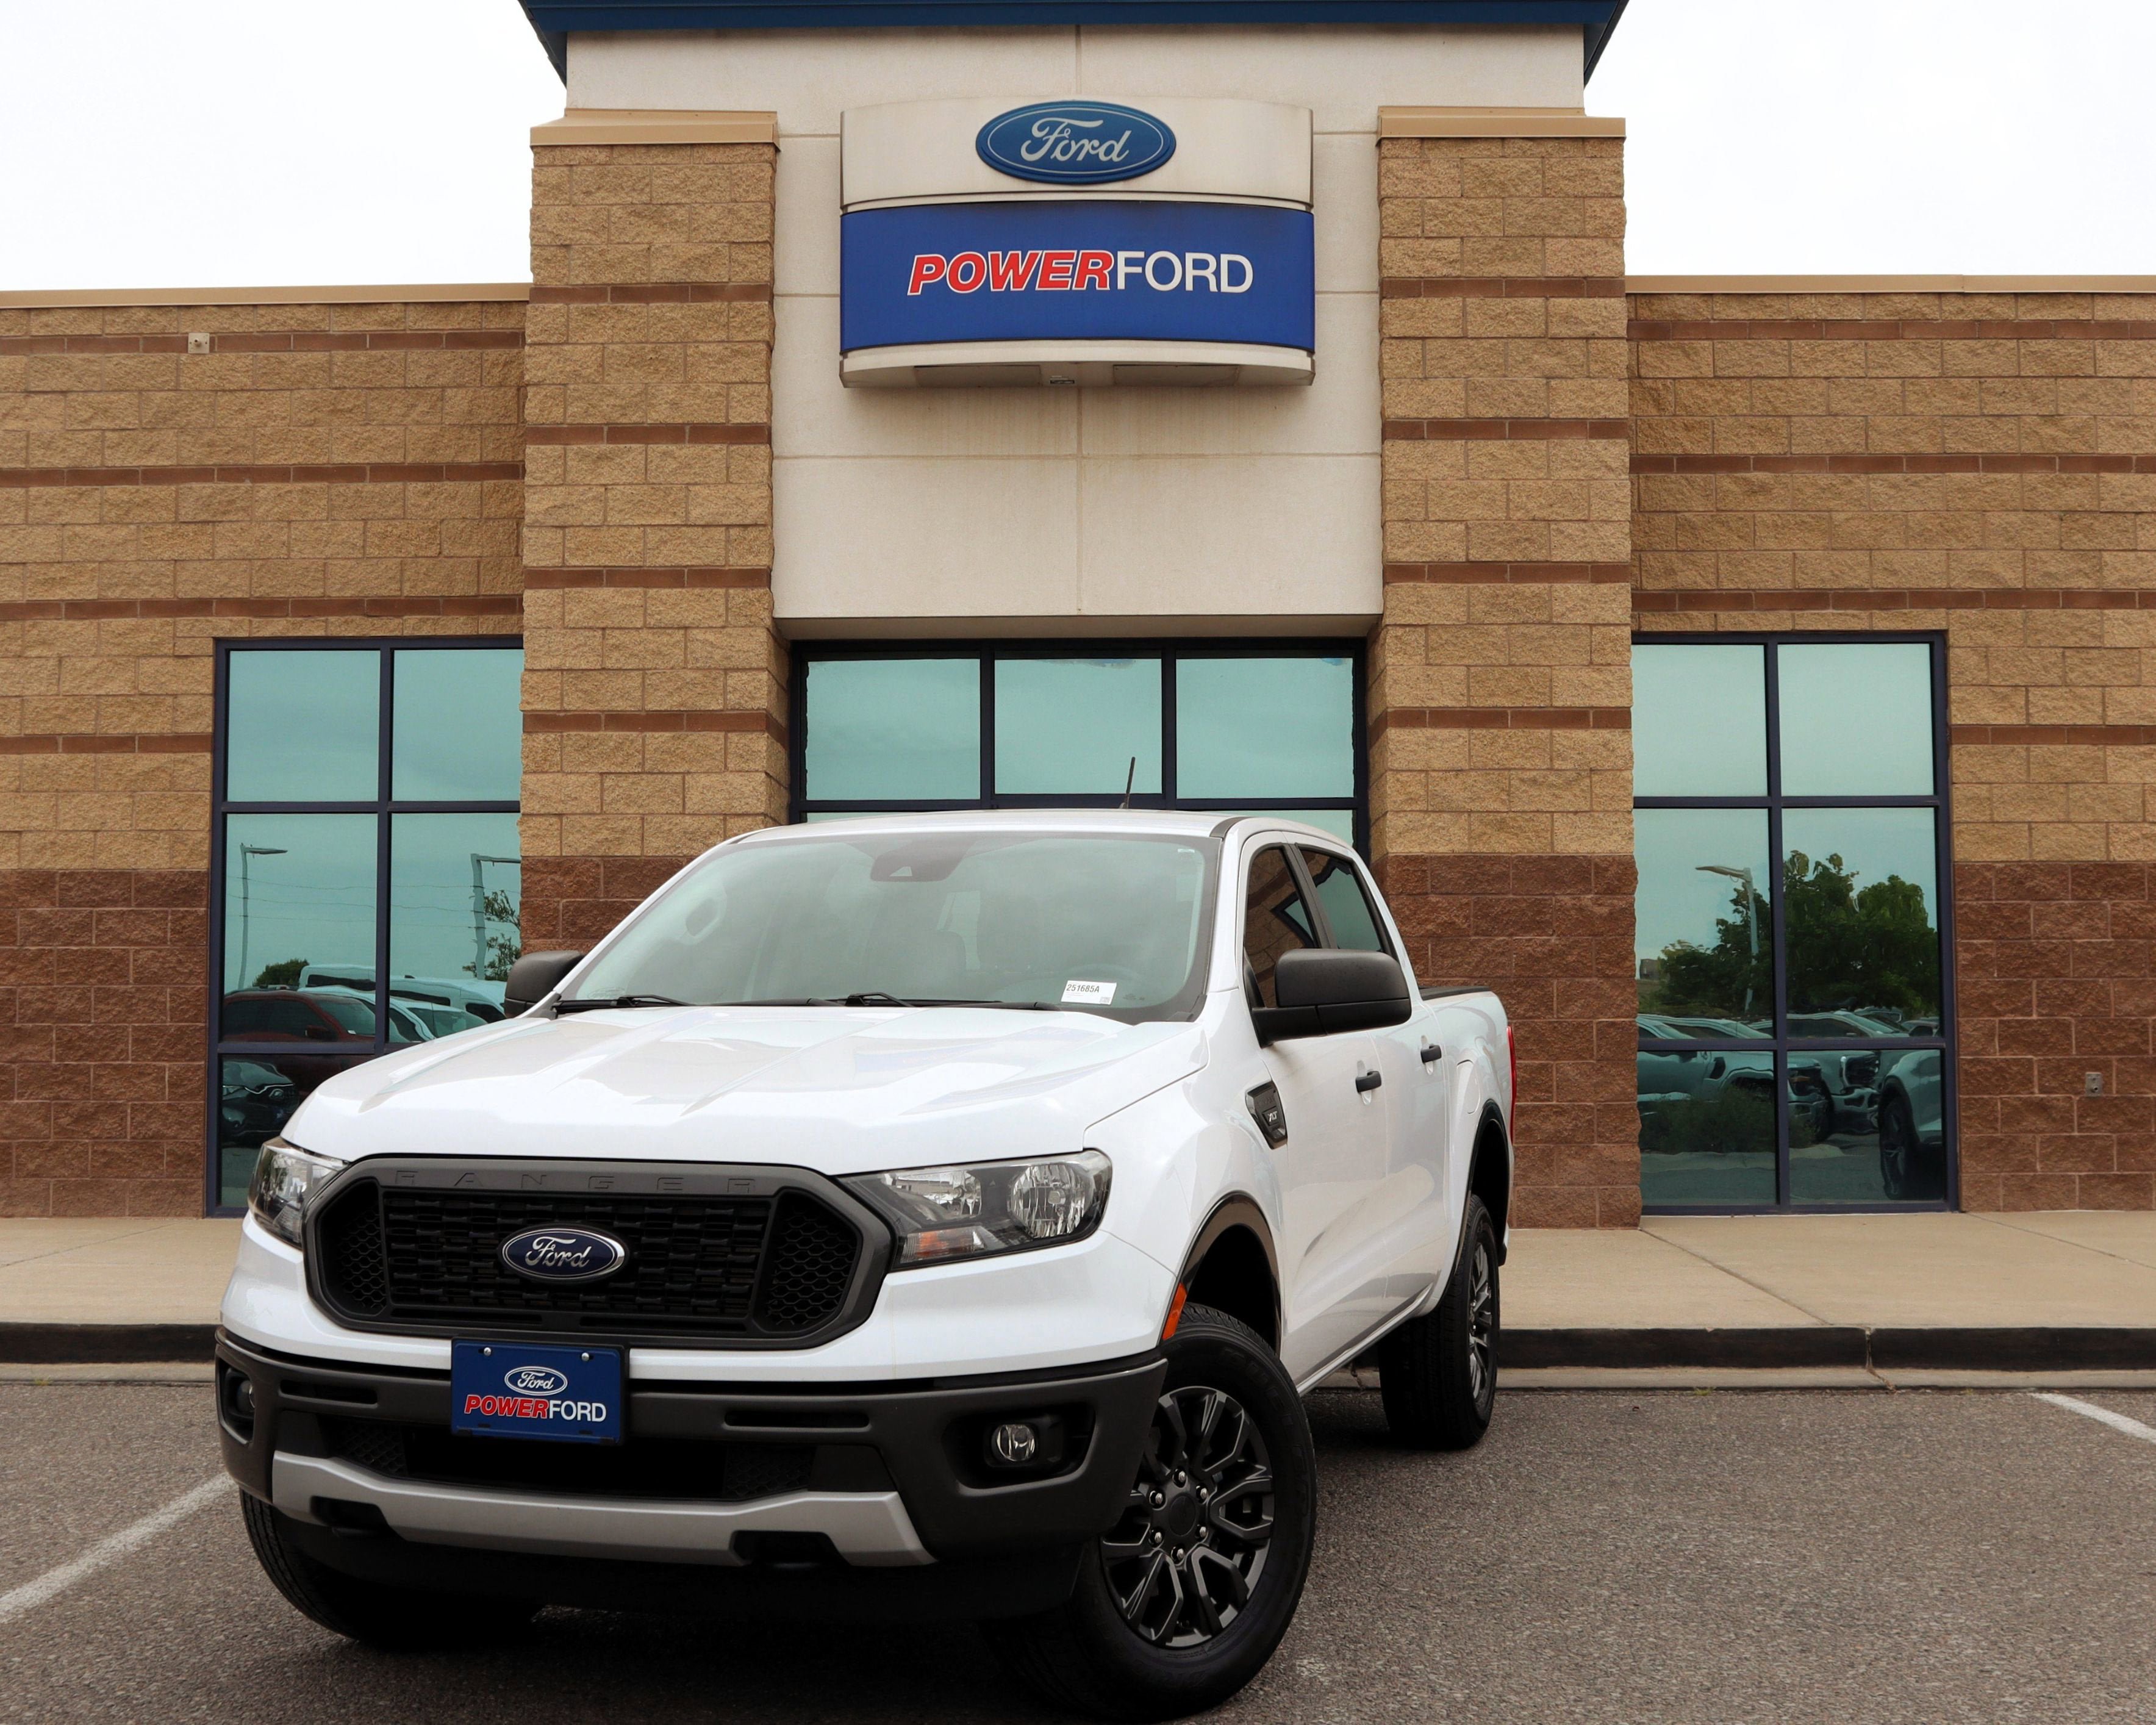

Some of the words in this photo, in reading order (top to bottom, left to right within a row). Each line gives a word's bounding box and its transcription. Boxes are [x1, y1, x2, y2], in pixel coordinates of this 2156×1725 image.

[1020, 117, 1133, 163] Ford
[906, 250, 1254, 296] POWERFORD
[1066, 984, 1100, 992] 251685A
[395, 1170, 756, 1194] RANGER
[525, 1236, 592, 1268] Ford
[517, 1371, 554, 1390] Ford
[464, 1395, 607, 1422] POWERFORD
